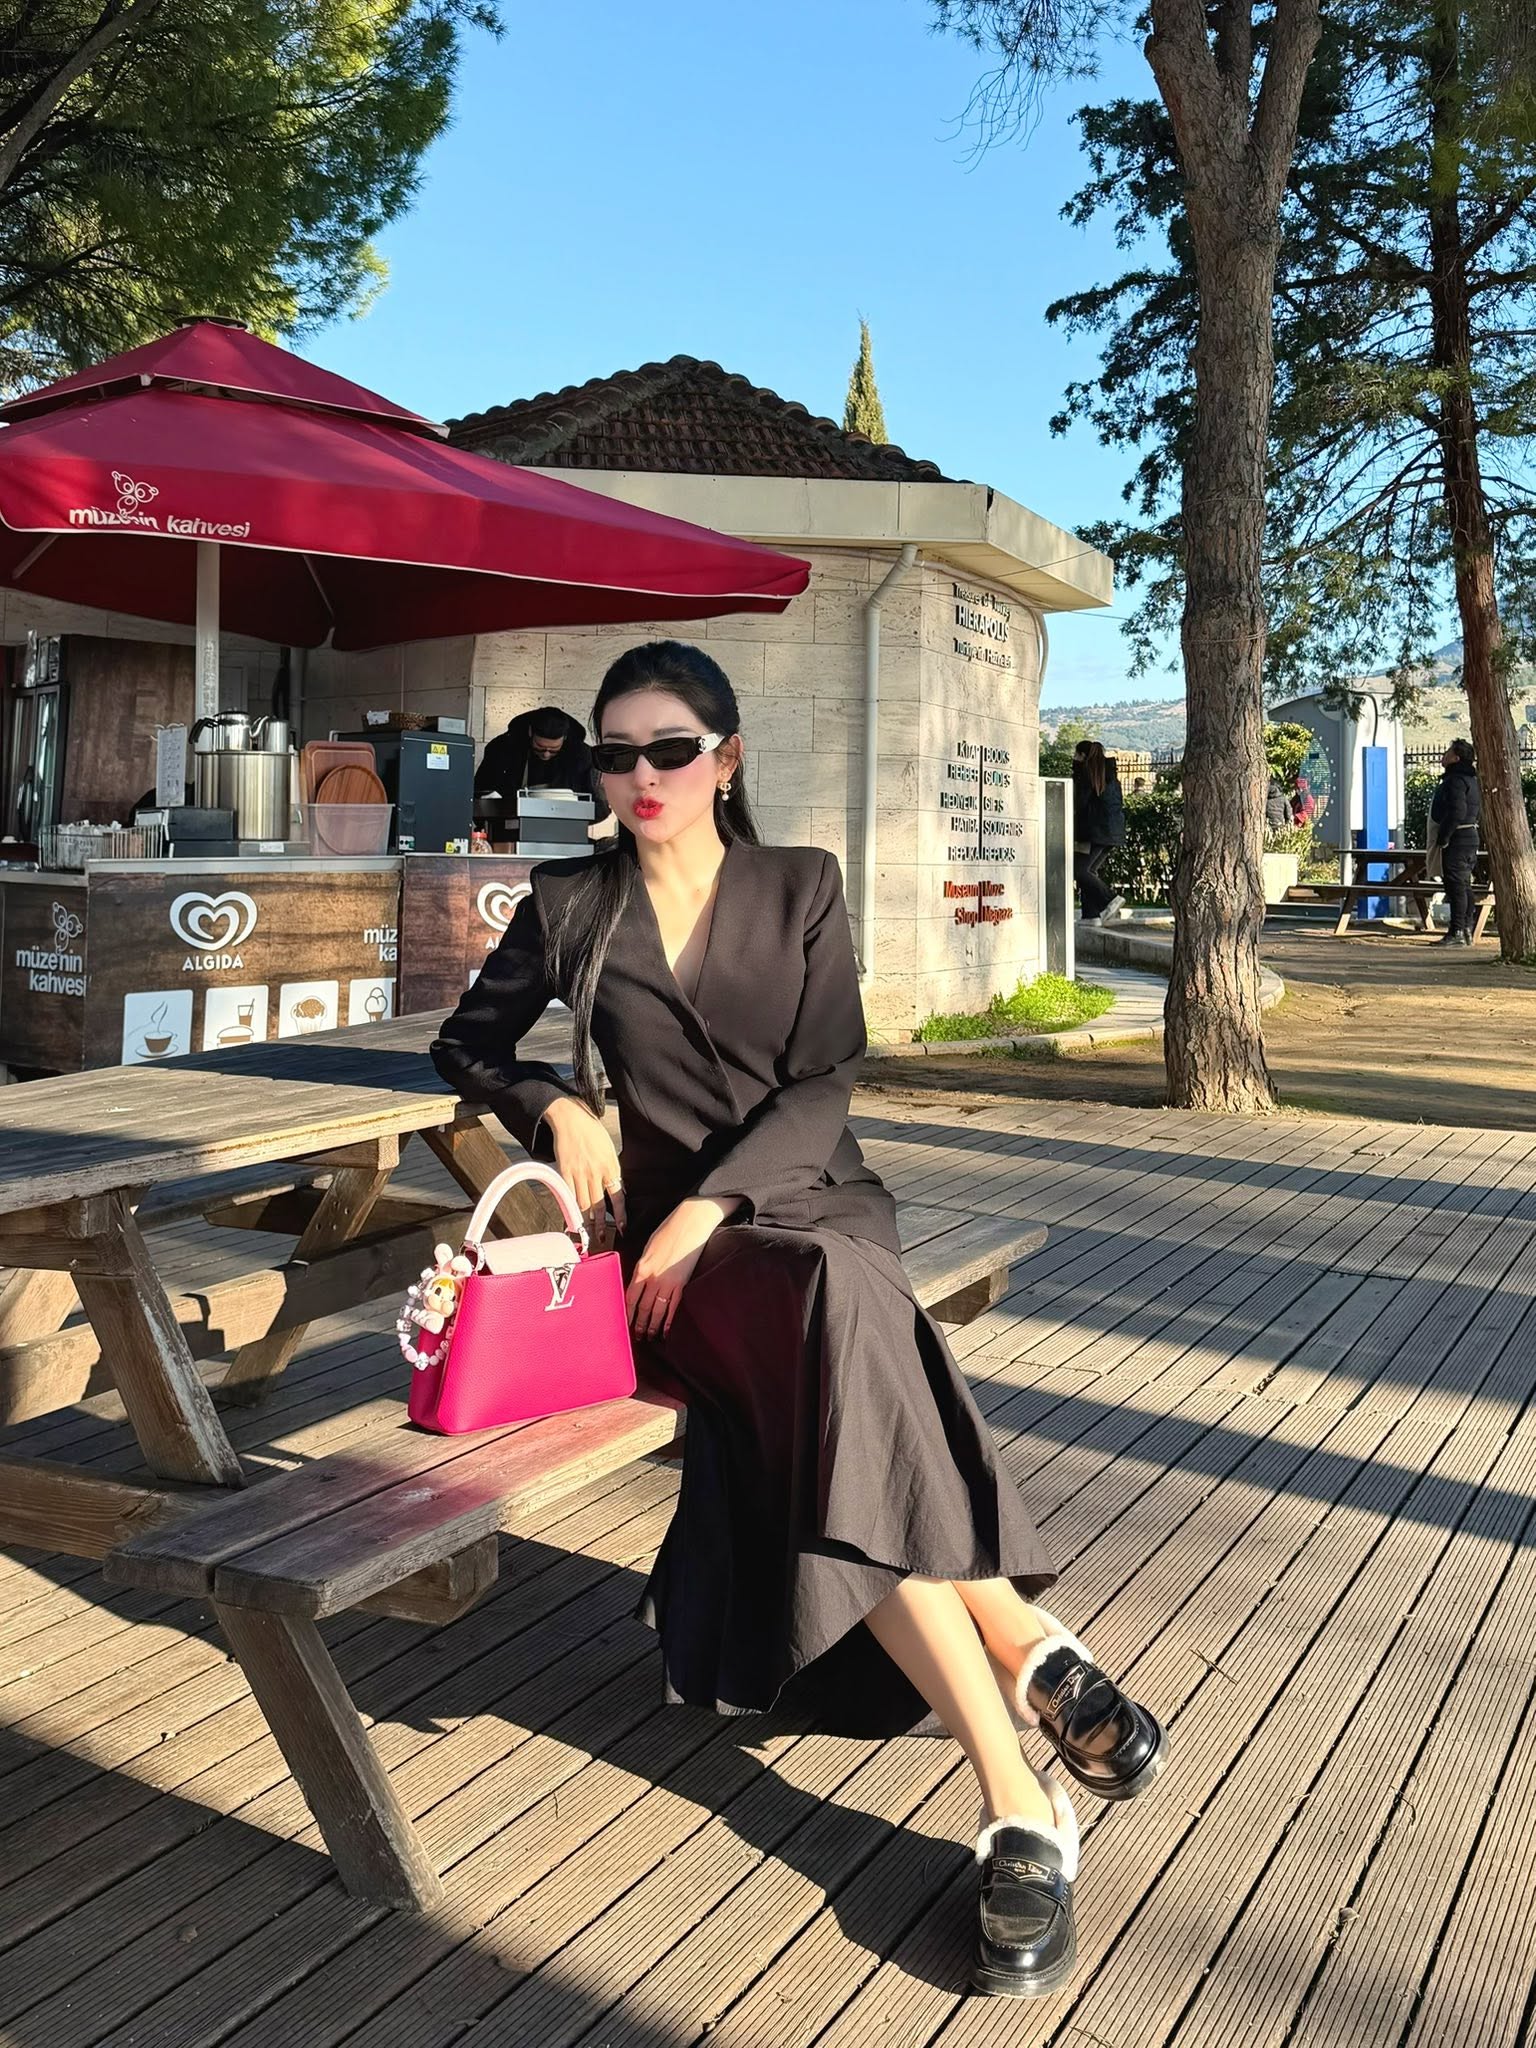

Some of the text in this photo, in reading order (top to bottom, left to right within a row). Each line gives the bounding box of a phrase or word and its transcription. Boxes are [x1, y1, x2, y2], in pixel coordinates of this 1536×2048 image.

[167, 515, 251, 538] kahvesi
[955, 605, 1010, 643] HIERAPOLIS
[182, 954, 244, 971] ALGIDA
[29, 969, 87, 997] kahvesi
